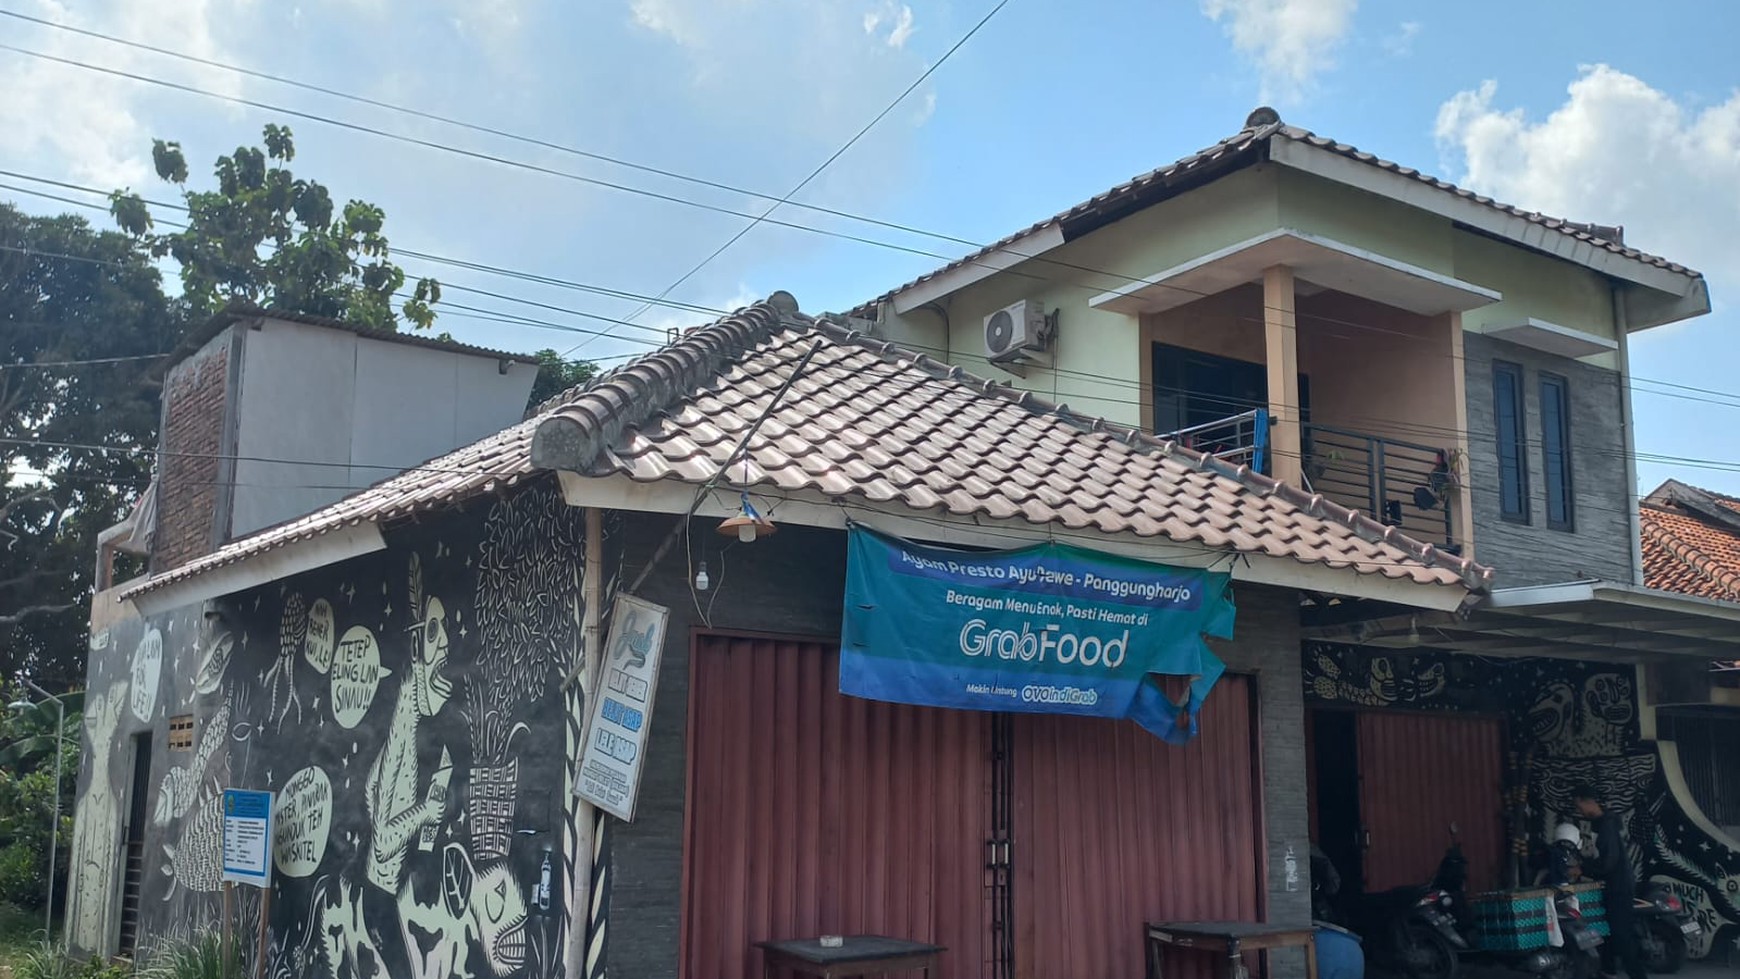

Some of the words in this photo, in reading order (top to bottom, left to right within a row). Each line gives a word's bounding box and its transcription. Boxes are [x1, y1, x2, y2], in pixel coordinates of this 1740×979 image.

[902, 551, 948, 572] Ayam
[949, 561, 1005, 578] Presto
[1008, 565, 1036, 585] Ayu
[1084, 573, 1191, 603] Panggungharjo
[946, 589, 1003, 611] Beragam
[1004, 598, 1036, 614] Menu
[1066, 604, 1097, 621] Pasti
[1098, 608, 1137, 626] Hemat
[1137, 613, 1149, 626] di
[341, 634, 371, 662] TETEP
[959, 618, 1130, 668] GrabFood
[360, 663, 379, 684] LAN
[966, 684, 990, 695] Makin
[308, 806, 324, 833] TEH
